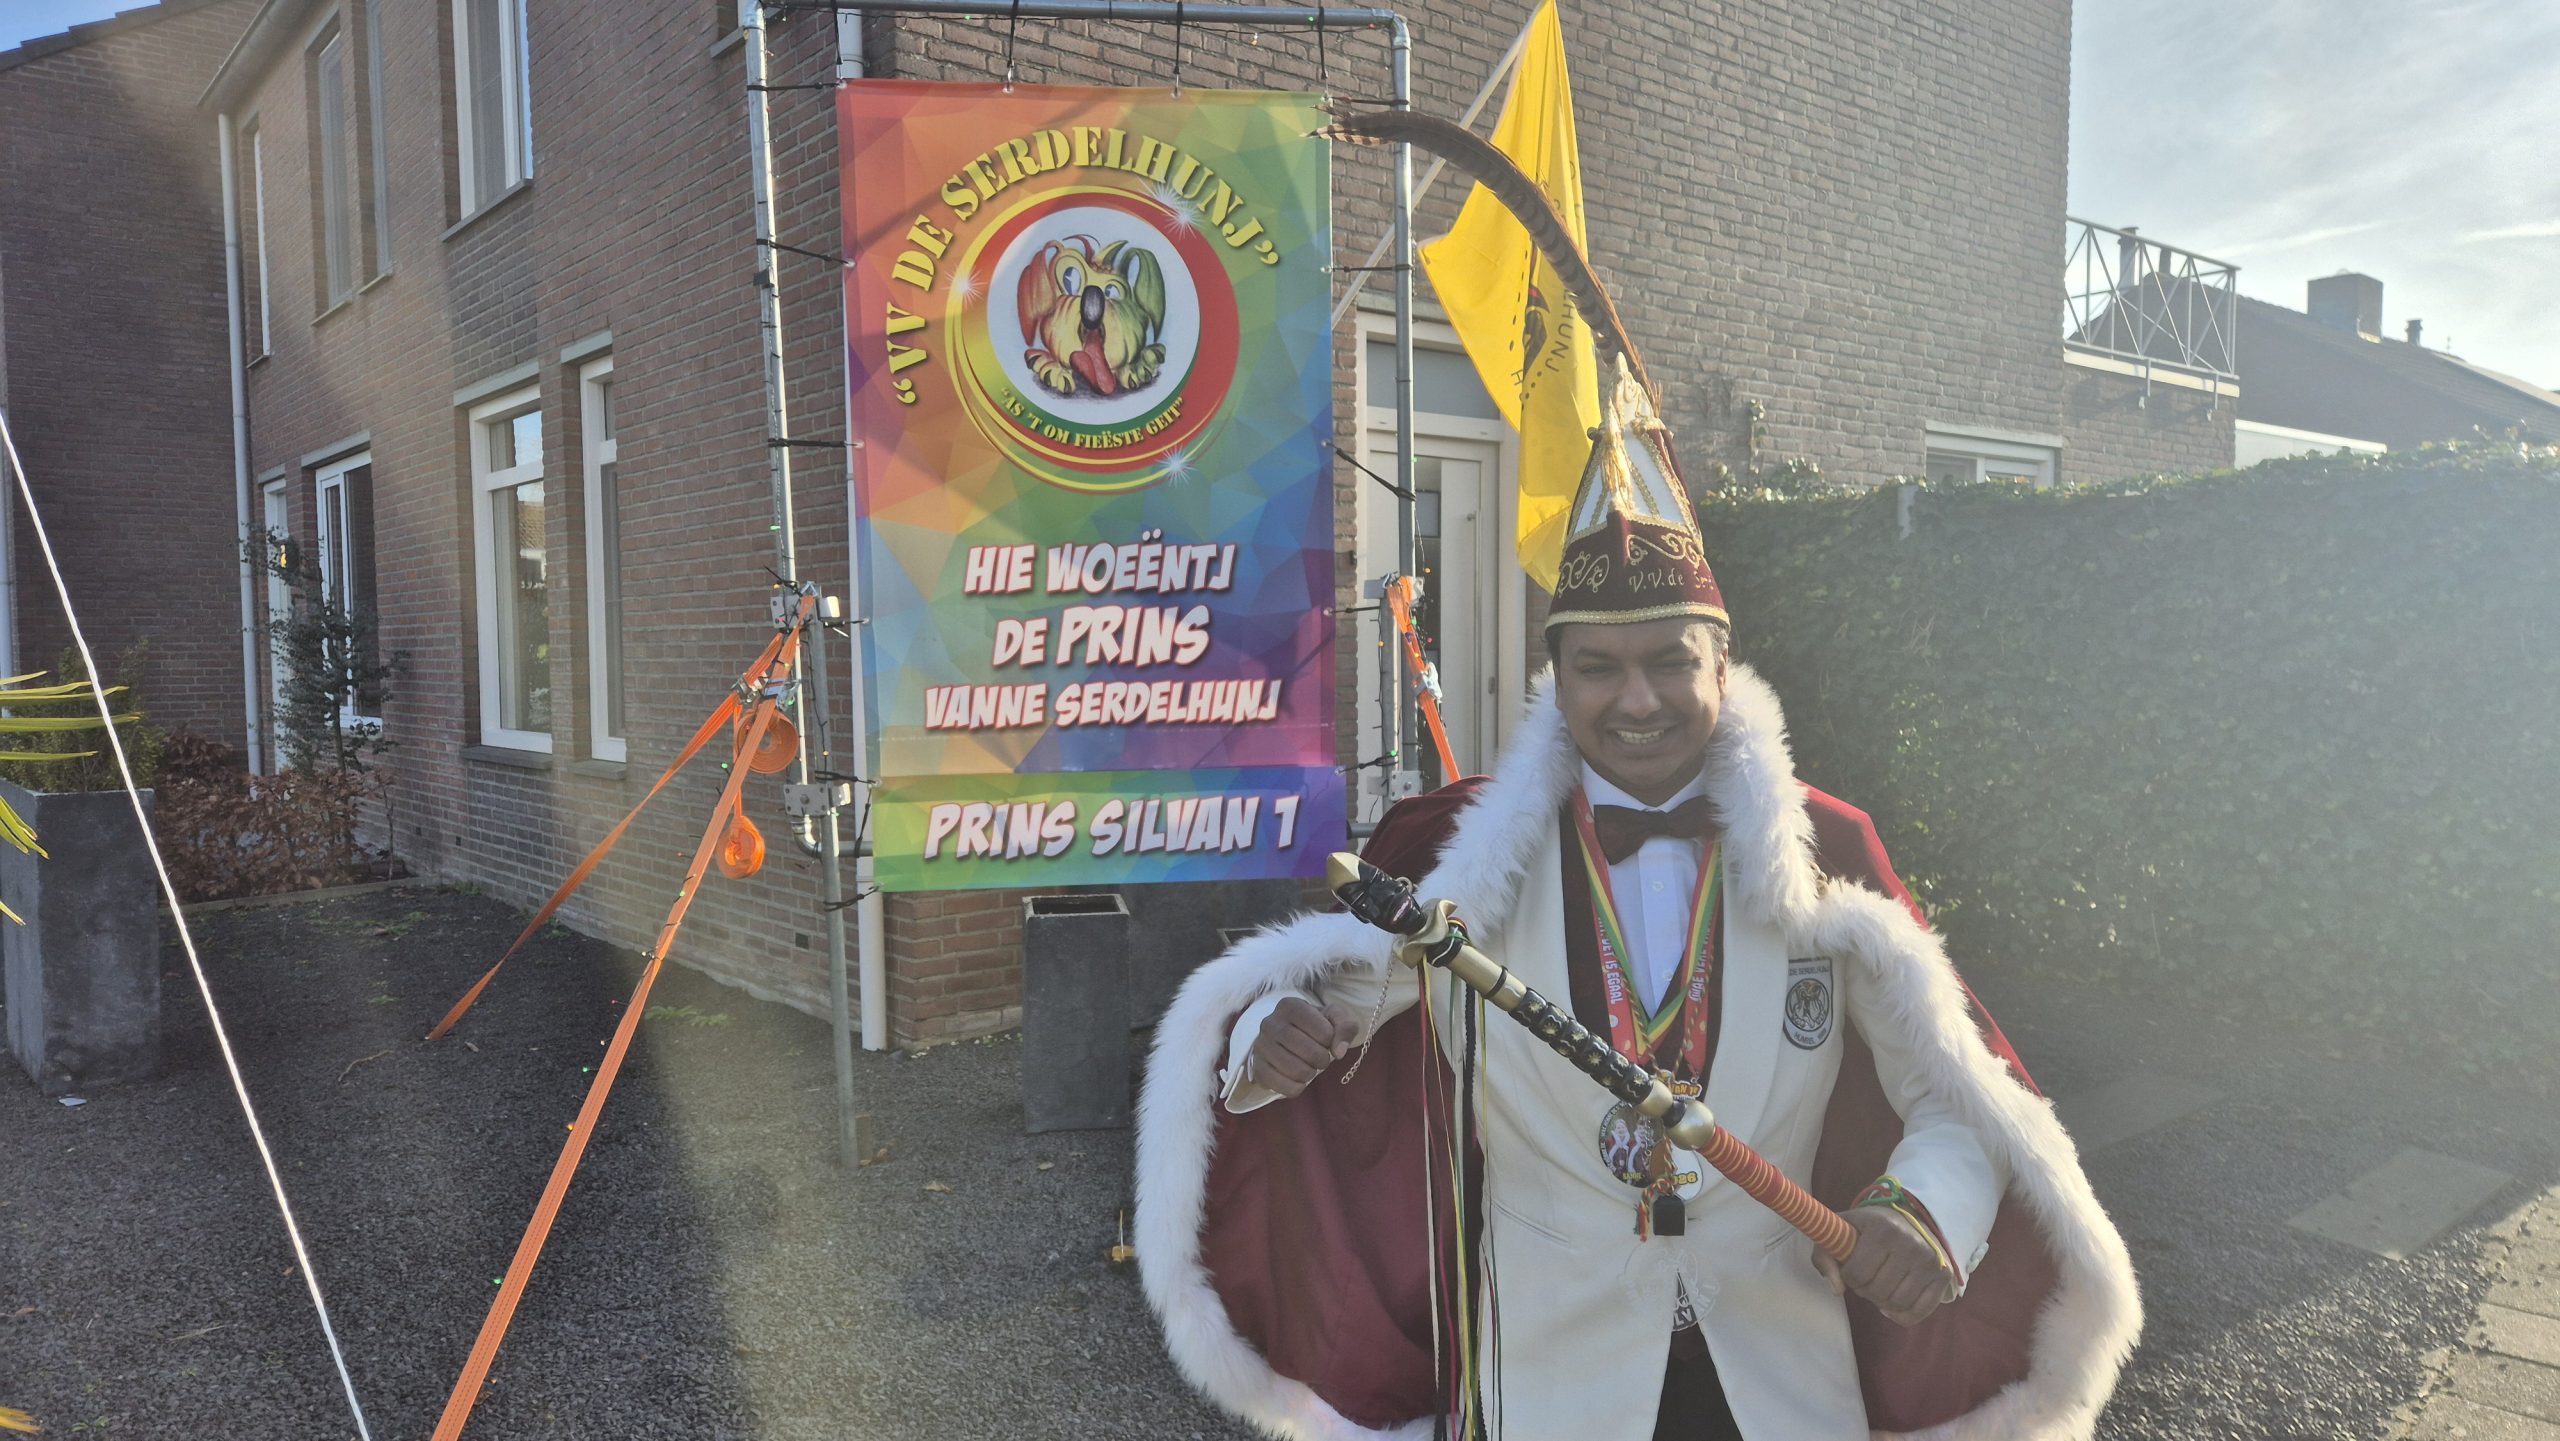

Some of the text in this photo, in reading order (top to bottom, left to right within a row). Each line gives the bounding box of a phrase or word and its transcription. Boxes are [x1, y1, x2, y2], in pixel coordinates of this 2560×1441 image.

[893, 214, 954, 292] DE
[1043, 424, 1070, 444] OM
[1074, 428, 1144, 449] FIEËSTE
[964, 529, 1236, 596] HIE WOEËNTJ
[993, 605, 1211, 668] DE PRINS
[925, 679, 1281, 730] VANNE SERDELHUNJ
[923, 795, 1300, 861] PRINS SILVAN 1
[1605, 960, 1618, 970] IS
[1607, 971, 1624, 1005] EGAAL
